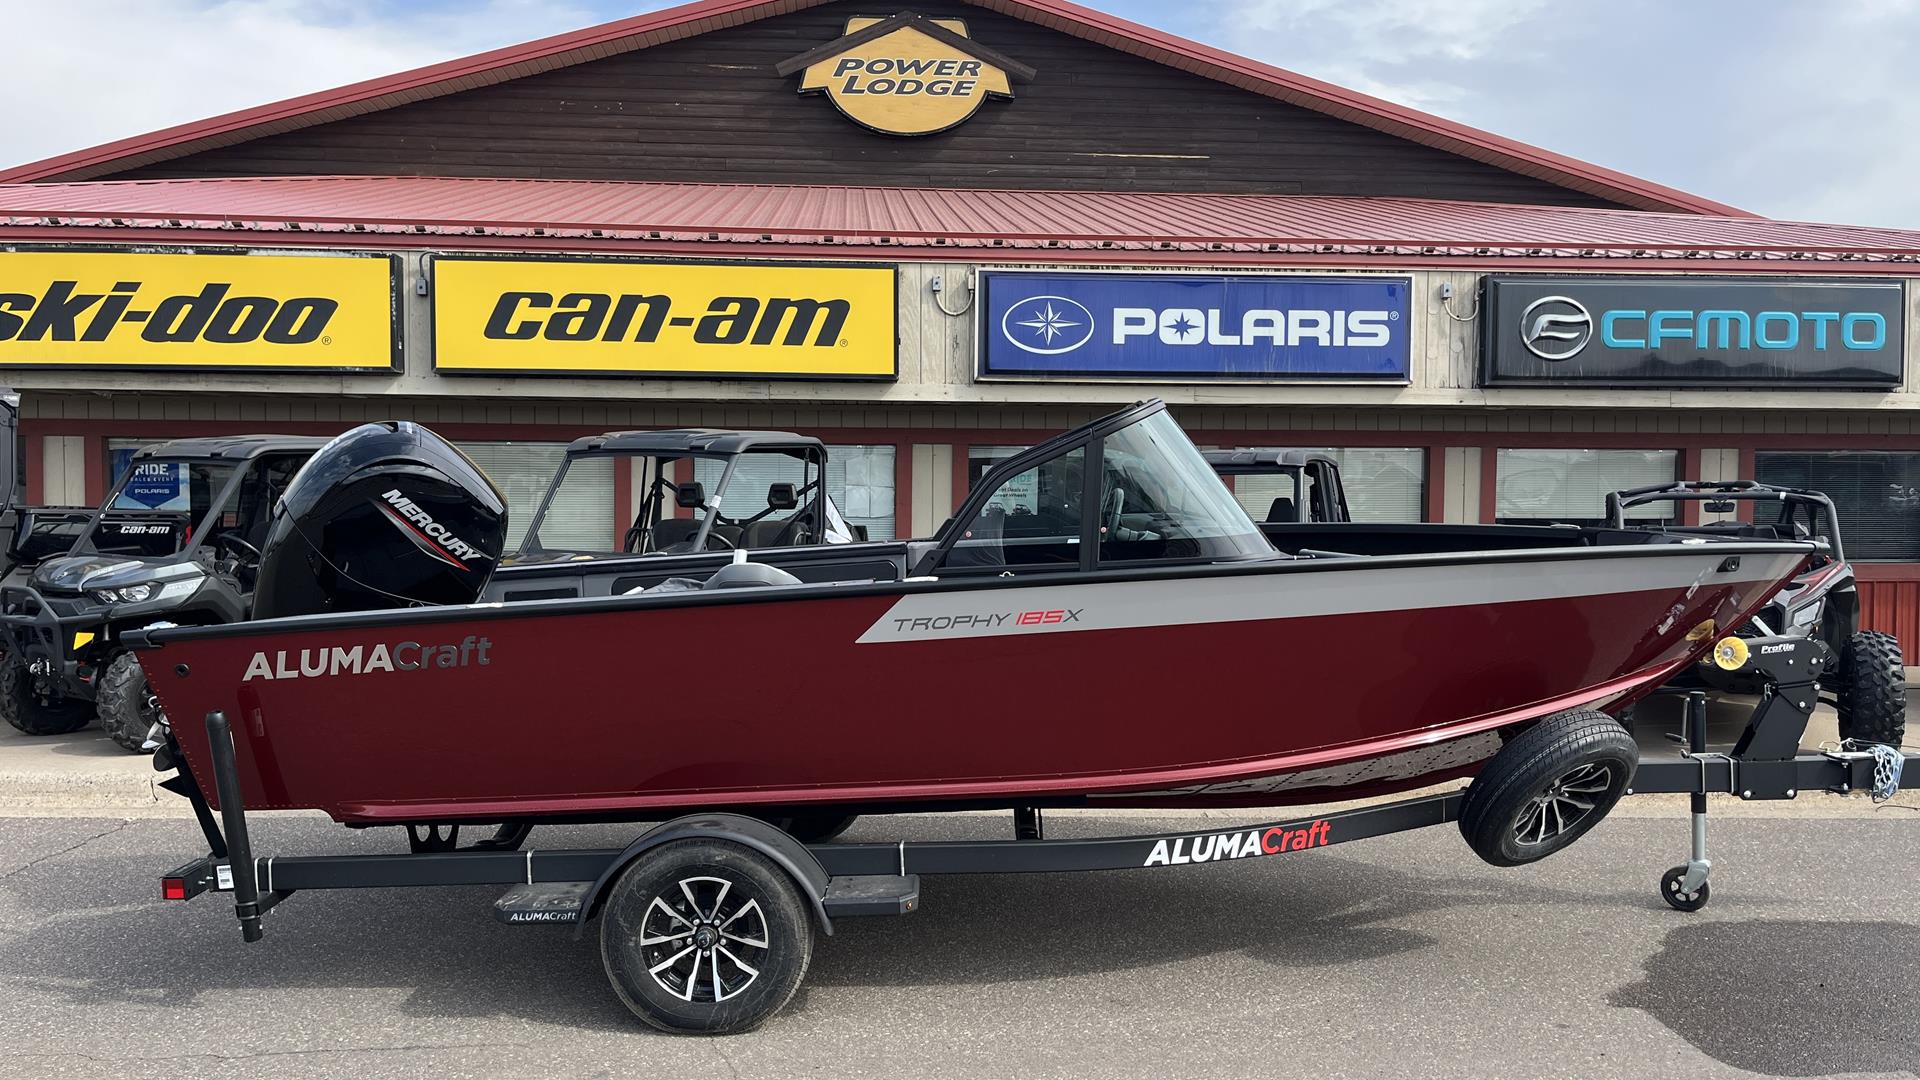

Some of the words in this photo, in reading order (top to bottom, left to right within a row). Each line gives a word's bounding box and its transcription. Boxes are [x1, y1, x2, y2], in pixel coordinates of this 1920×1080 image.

[832, 58, 982, 78] POWER
[841, 75, 976, 97] LODGE
[484, 291, 850, 347] can-am
[1113, 307, 1390, 347] POLARIS
[1601, 309, 1886, 351] CFMOTO
[135, 464, 169, 476] RIDE
[120, 526, 170, 534] can-am
[381, 489, 481, 561] MERCURY
[894, 613, 1012, 632] TROPHY
[1015, 608, 1084, 625] 185X
[242, 636, 492, 681] ALUMACraft
[1761, 643, 1795, 654] Profile
[1143, 820, 1331, 867] ALUMACraft
[510, 912, 577, 921] ALUMACraft
